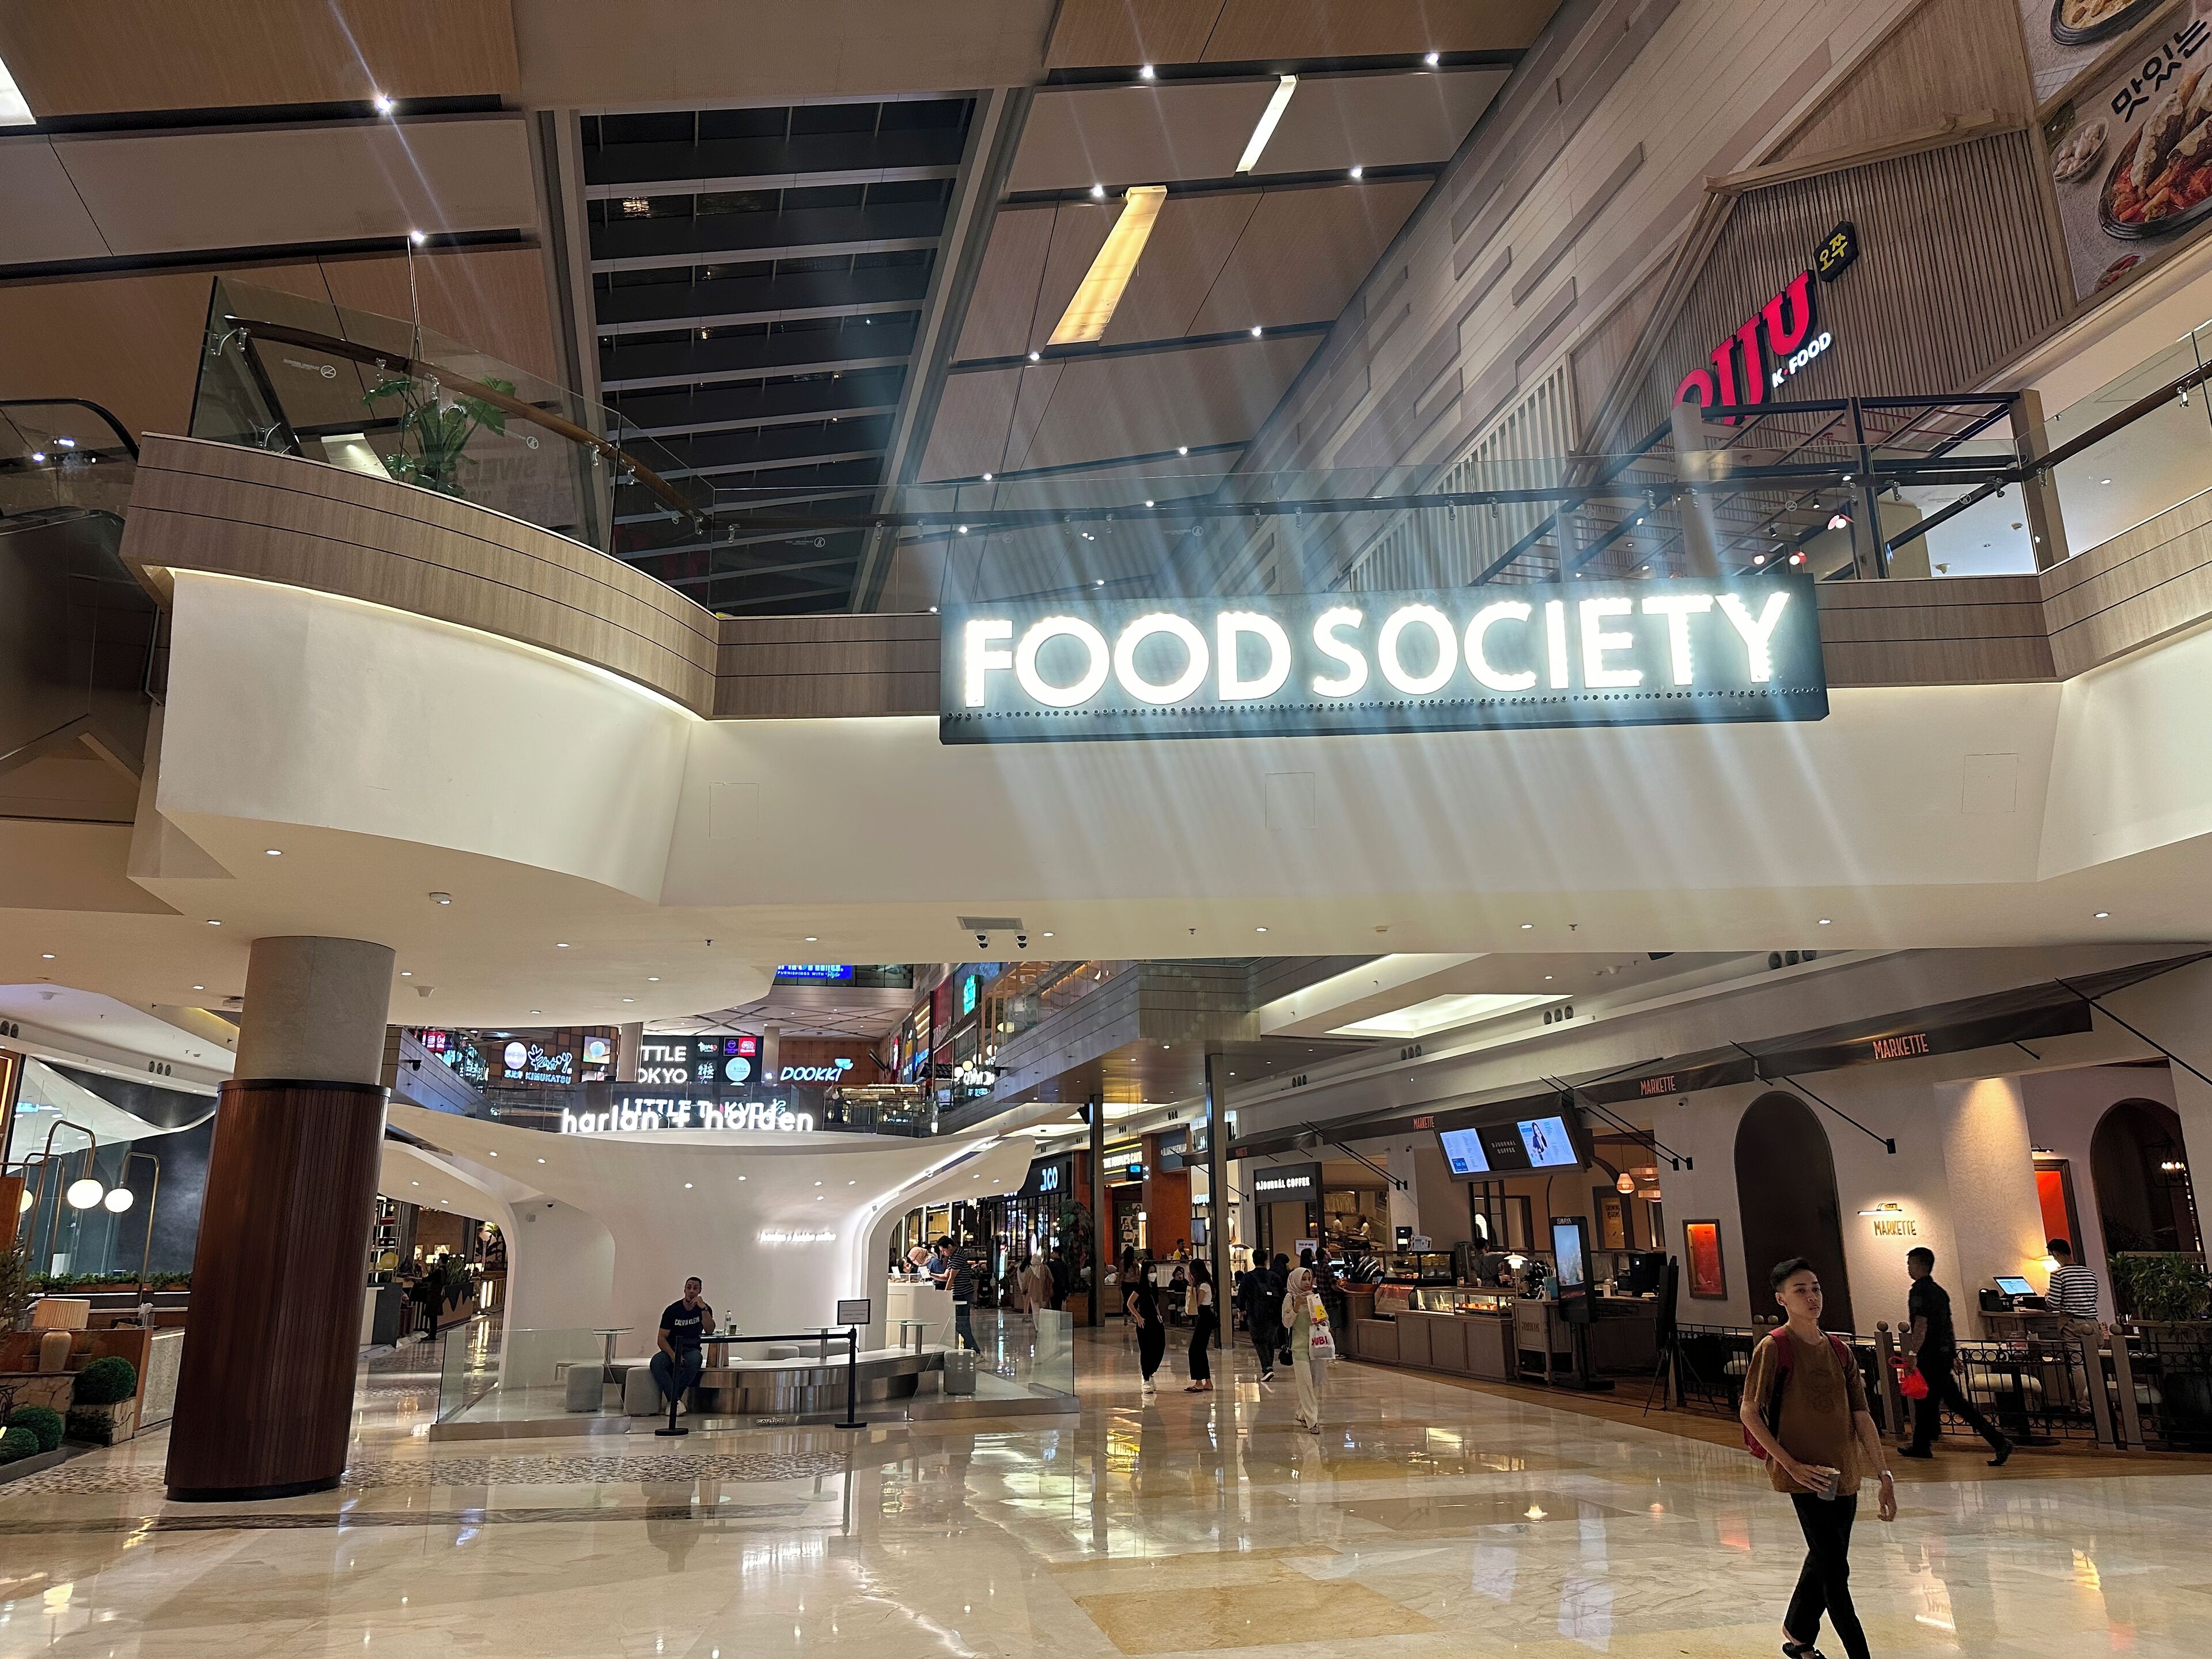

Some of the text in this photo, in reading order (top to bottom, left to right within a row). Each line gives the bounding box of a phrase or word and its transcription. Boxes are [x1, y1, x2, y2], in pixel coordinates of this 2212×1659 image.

[2111, 19, 2211, 123] 맛있는
[965, 592, 1790, 708] FOOD SOCIETY
[1873, 1033, 1929, 1060] MARKETTE
[525, 1072, 571, 1084] KIMUKATSU
[780, 1067, 843, 1082] DOOKKI
[1641, 1075, 1676, 1096] MARKETTE
[561, 1105, 660, 1133] harlan
[704, 1102, 814, 1132] holden
[1286, 1176, 1310, 1188] COFFEE
[1874, 1221, 1917, 1236] MARKETTE
[688, 1316, 700, 1325] KLEIN
